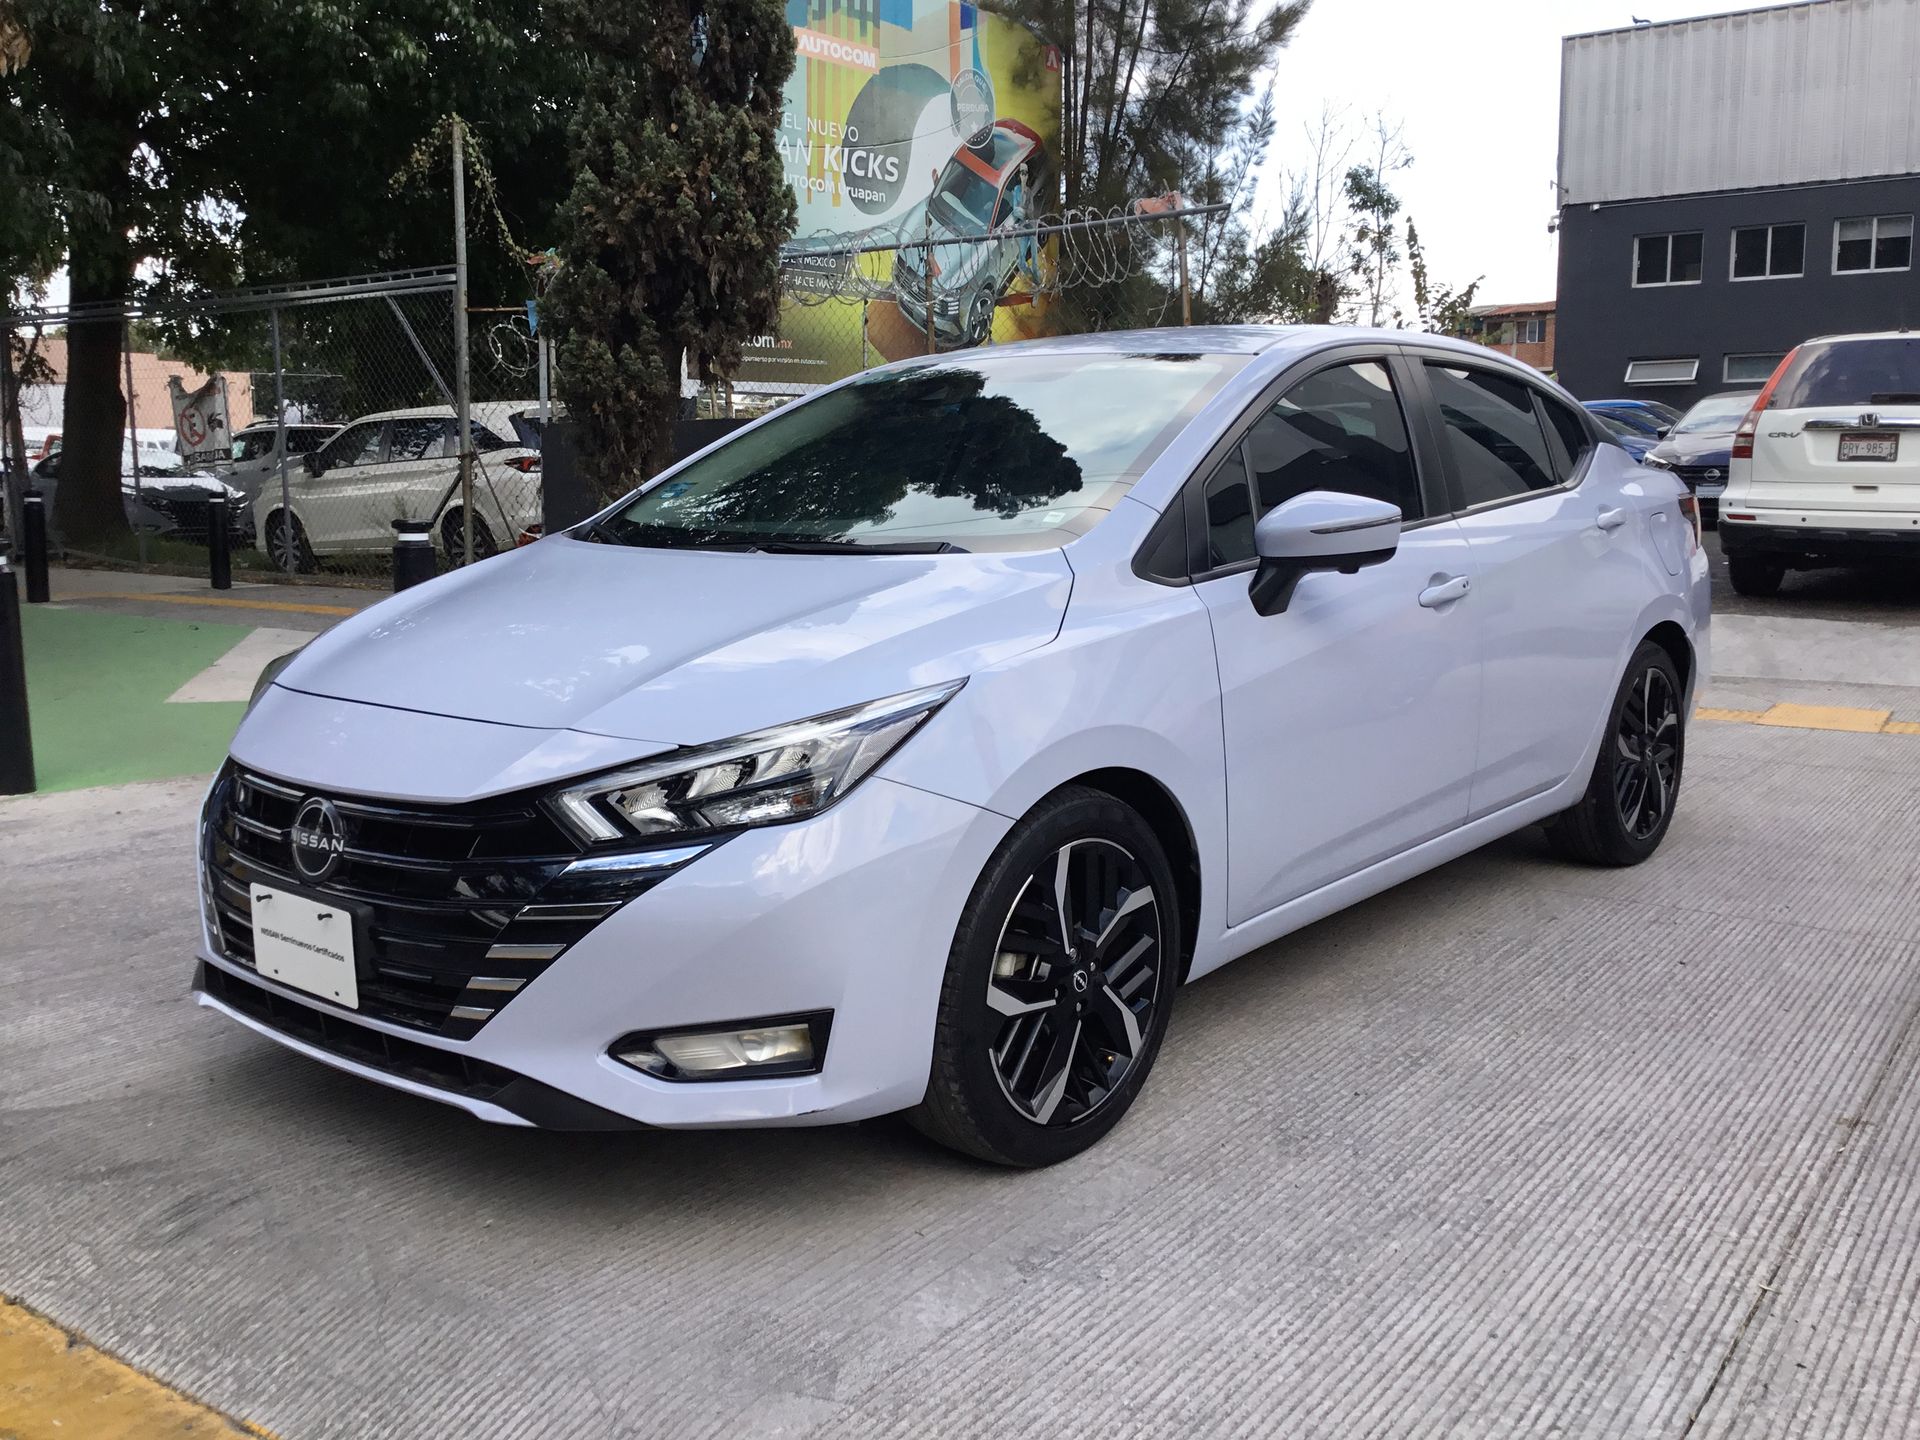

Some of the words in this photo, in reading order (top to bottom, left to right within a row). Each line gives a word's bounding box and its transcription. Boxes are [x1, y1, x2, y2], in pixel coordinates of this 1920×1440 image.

[799, 34, 875, 68] AUTOCOM
[957, 103, 990, 112] PERDURA
[784, 112, 802, 130] EL
[807, 117, 859, 142] NUEVO
[779, 134, 813, 166] AN
[823, 143, 899, 182] KICKS
[783, 172, 836, 194] UTOCOM
[838, 182, 886, 203] Uruapan
[1768, 431, 1801, 439] CR-V
[261, 927, 280, 940] NISSAN
[313, 944, 344, 962] Certificados
